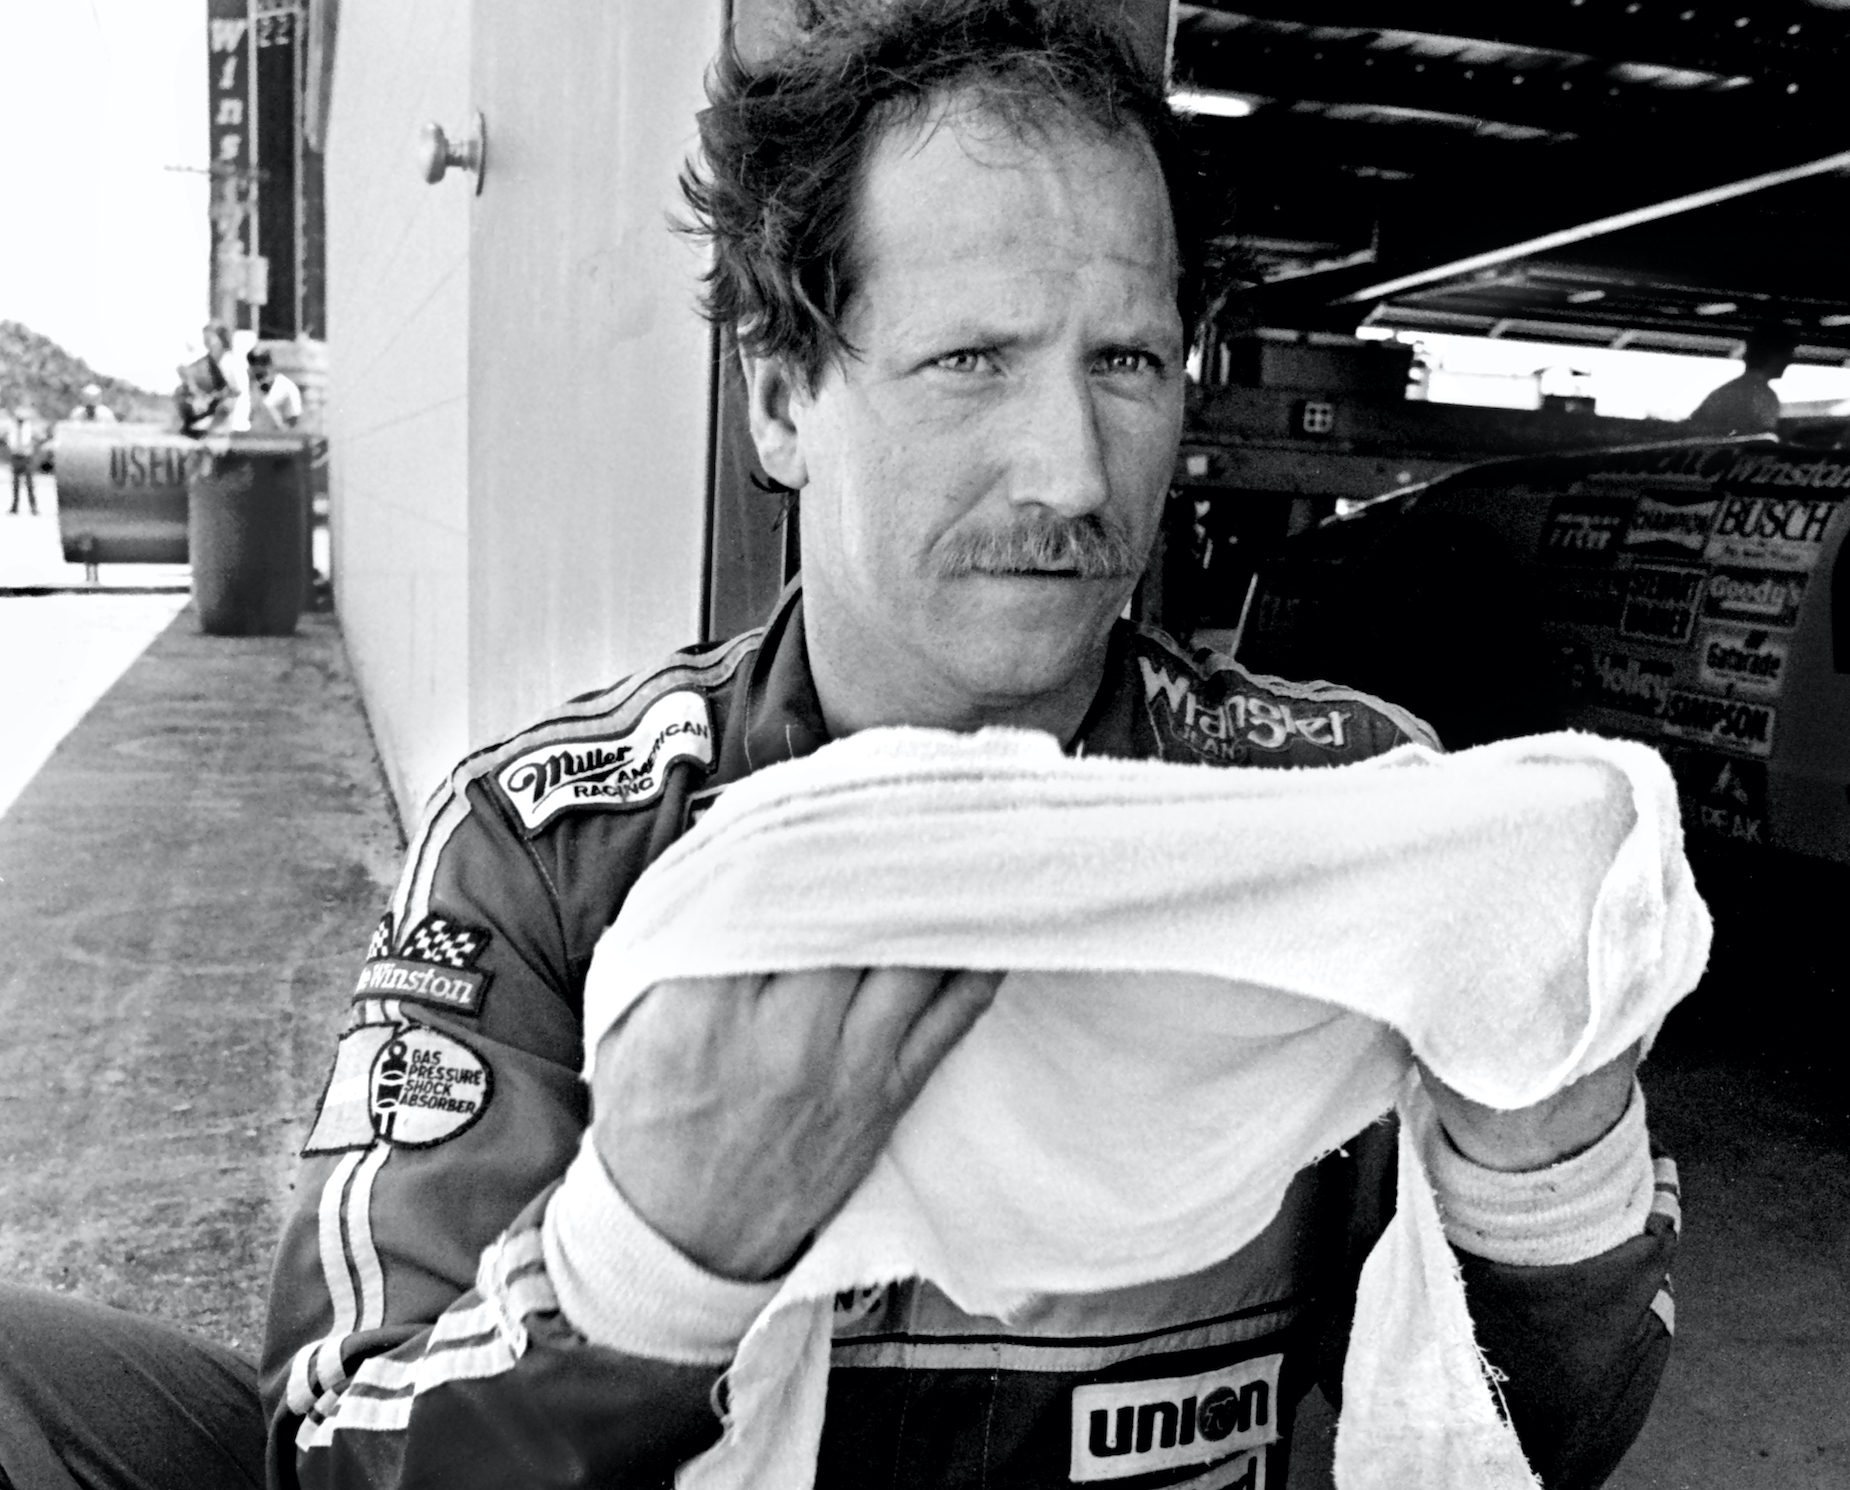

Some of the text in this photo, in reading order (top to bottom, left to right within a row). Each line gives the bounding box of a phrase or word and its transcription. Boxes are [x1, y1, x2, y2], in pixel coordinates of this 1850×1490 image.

[1716, 499, 1836, 542] BUSCH
[1137, 656, 1352, 748] Wrangler
[1668, 695, 1770, 742] SIMPSON
[507, 745, 633, 803] Miller
[573, 777, 655, 798] RACING
[1699, 804, 1763, 845] PEAK
[370, 962, 474, 1003] Winston
[408, 1063, 484, 1086] PRESSURE
[411, 1048, 442, 1065] GAS
[398, 1092, 477, 1115] ABSORBER
[403, 1079, 453, 1096] SHOCK
[1088, 1379, 1270, 1458] union
